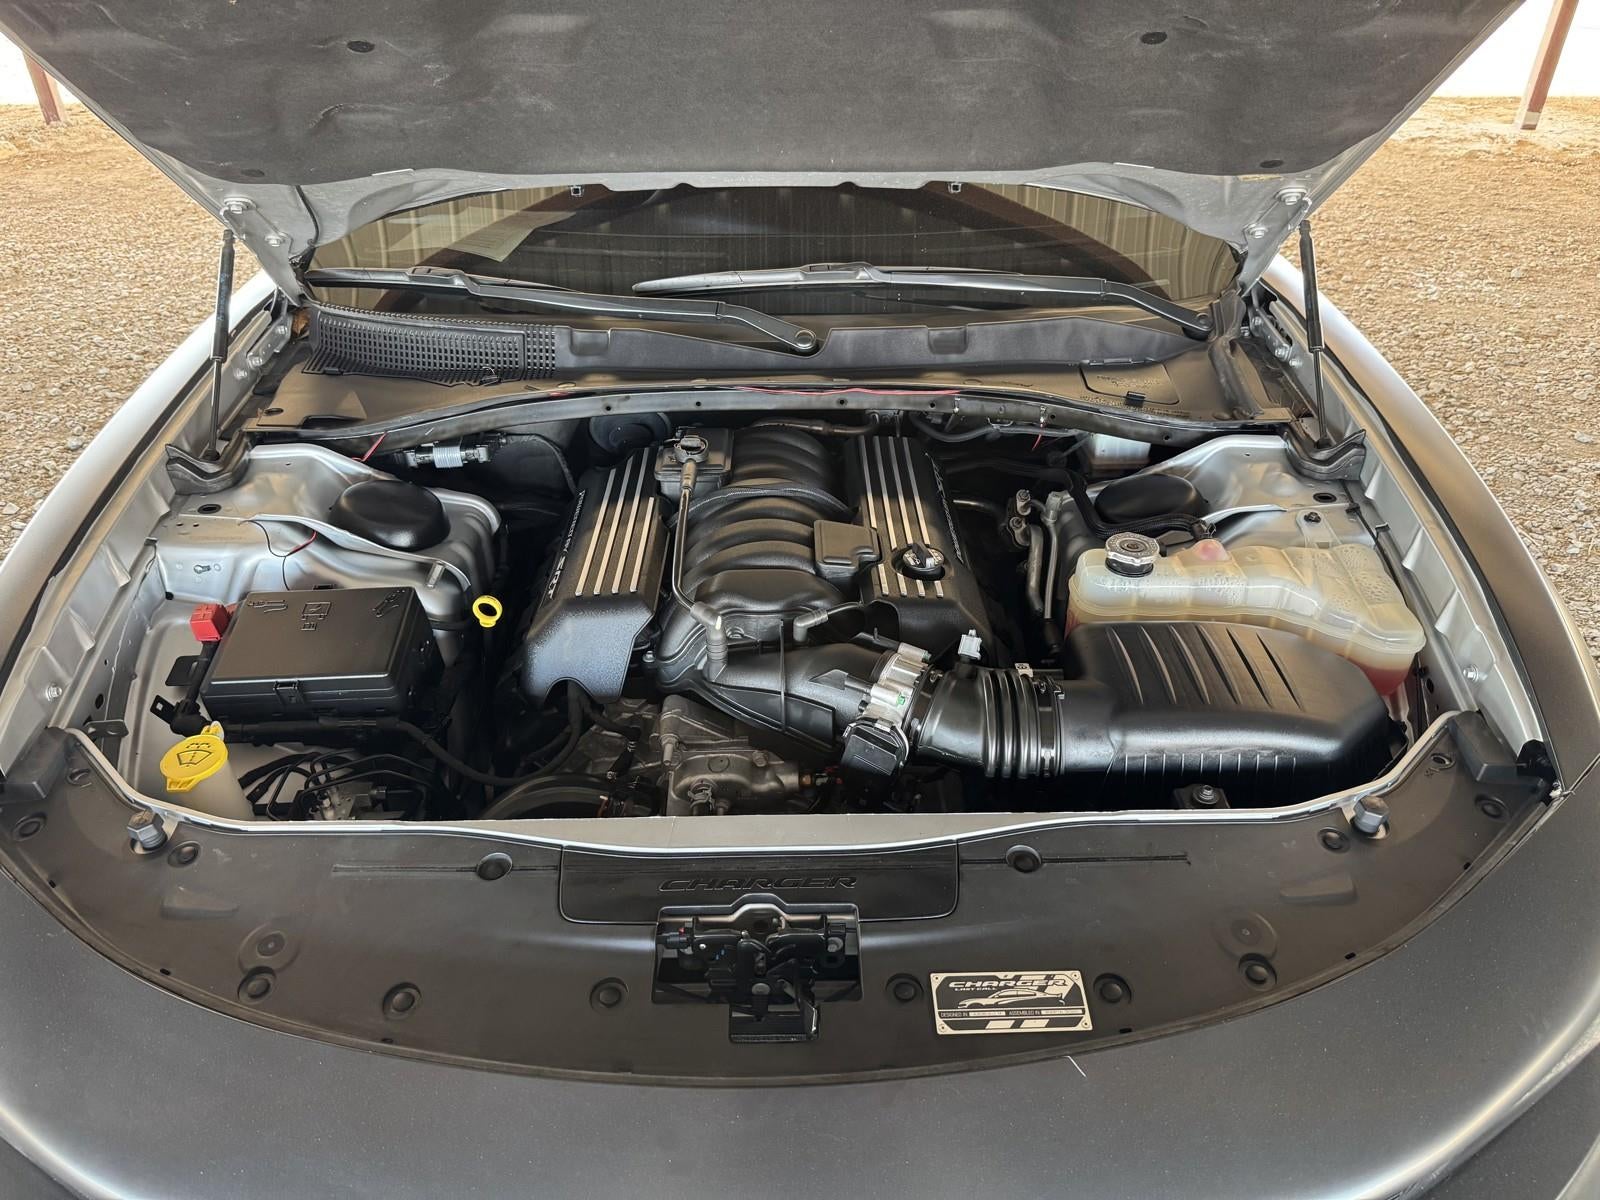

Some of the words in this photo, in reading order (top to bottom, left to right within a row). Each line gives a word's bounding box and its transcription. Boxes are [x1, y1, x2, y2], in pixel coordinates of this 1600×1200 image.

[548, 556, 566, 600] SRT
[658, 876, 857, 892] CHARGER
[948, 979, 1068, 988] CHARGER
